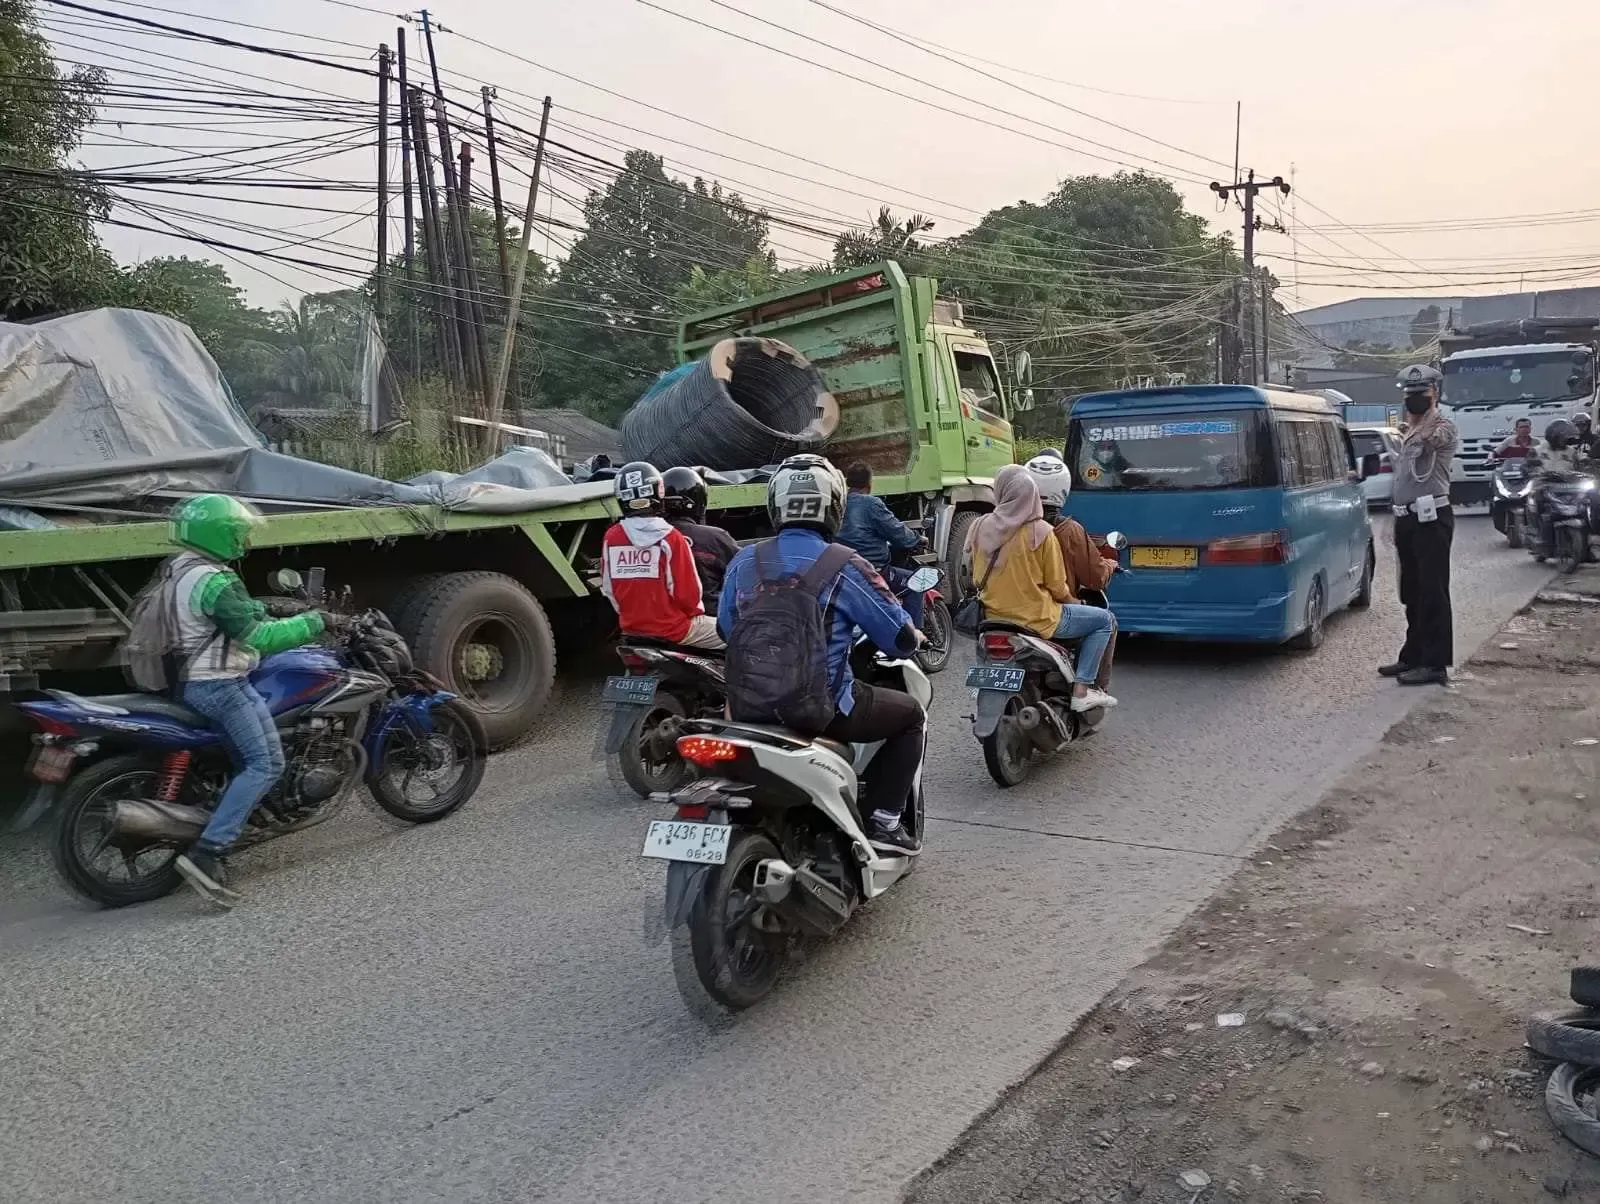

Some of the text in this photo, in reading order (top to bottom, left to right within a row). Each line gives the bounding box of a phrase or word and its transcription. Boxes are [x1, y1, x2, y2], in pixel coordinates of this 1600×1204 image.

[786, 497, 823, 518] 93
[616, 549, 652, 565] AIKO
[650, 822, 661, 837] F
[665, 823, 699, 840] 3436
